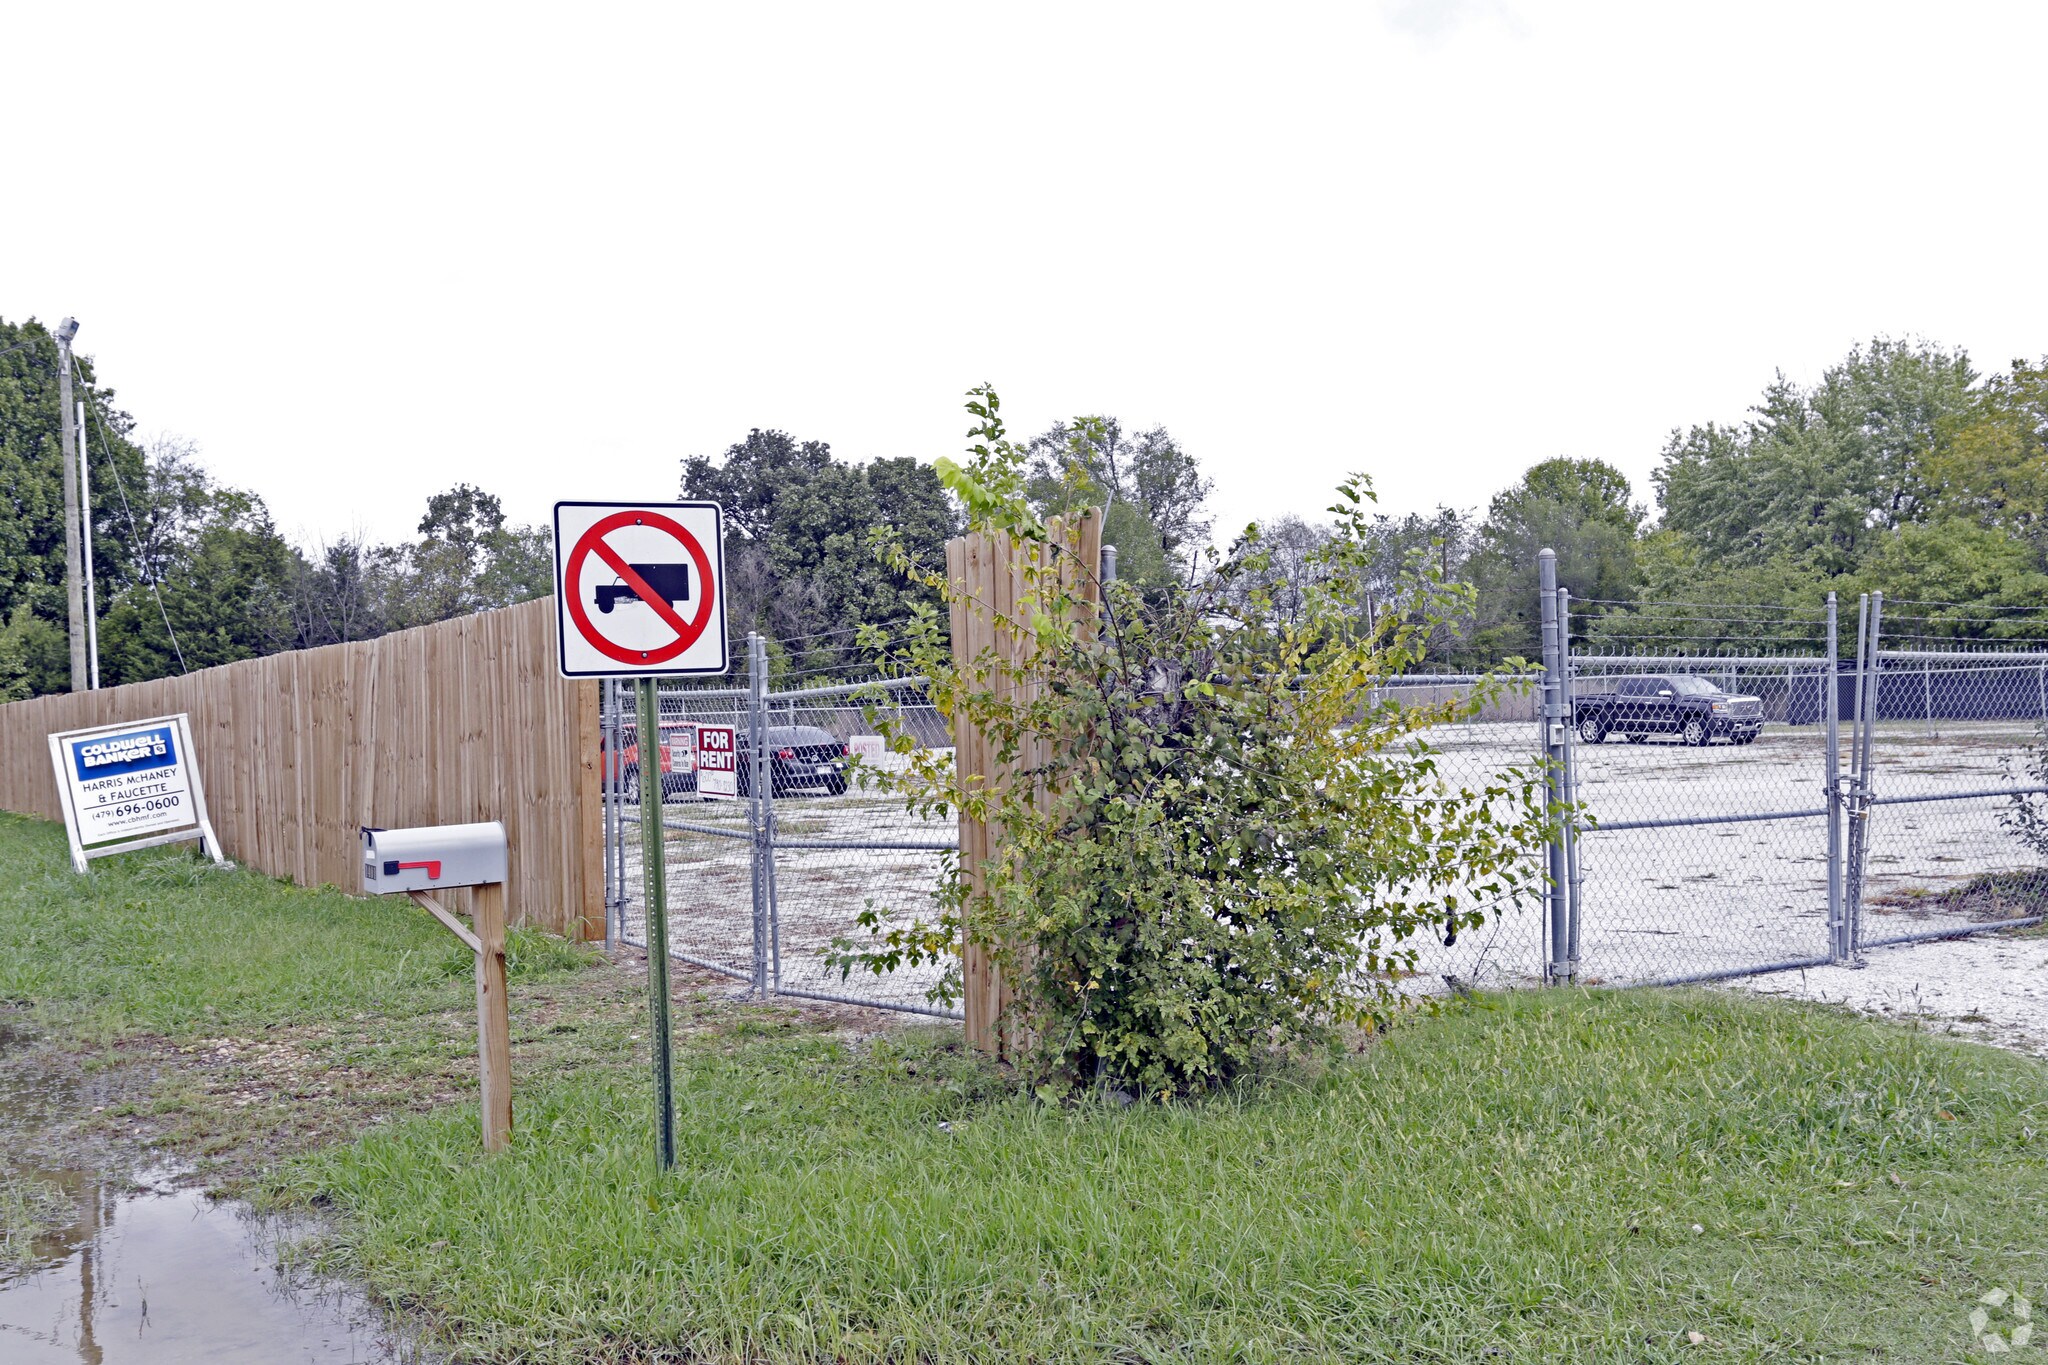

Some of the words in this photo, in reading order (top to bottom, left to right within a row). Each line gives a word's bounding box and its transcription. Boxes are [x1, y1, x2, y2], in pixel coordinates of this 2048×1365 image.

[81, 734, 165, 756] COLDWELL
[703, 731, 729, 749] FOR
[83, 747, 151, 767] BANKER
[854, 743, 880, 758] POSTED
[700, 751, 733, 769] RENT
[83, 778, 123, 792] HARRIS
[98, 794, 107, 803] &
[110, 783, 167, 801] FAUCETTE
[92, 810, 114, 821] (479)
[116, 796, 179, 817] 696-0600
[108, 811, 167, 827] www.cbhmf.com
